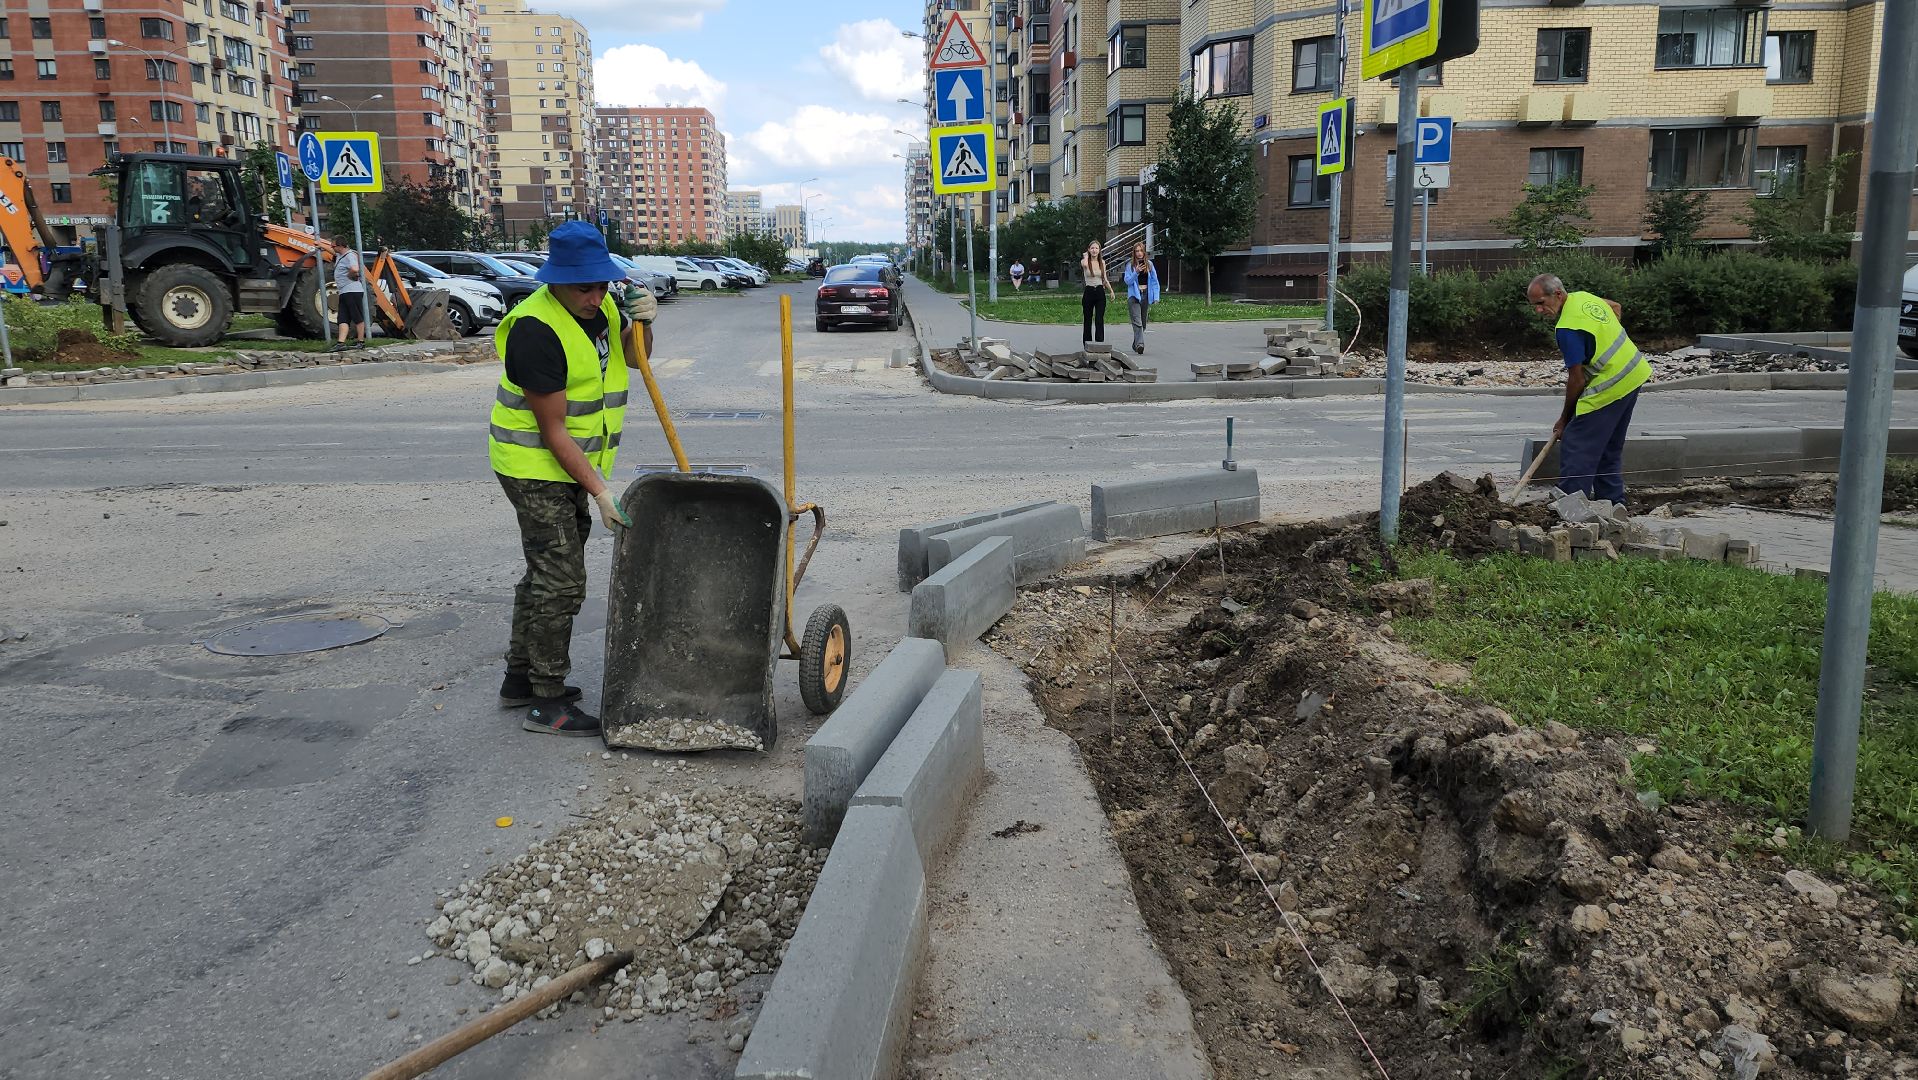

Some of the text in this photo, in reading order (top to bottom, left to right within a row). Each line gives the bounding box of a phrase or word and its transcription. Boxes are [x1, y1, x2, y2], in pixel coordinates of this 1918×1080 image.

[1416, 122, 1443, 159] P
[279, 156, 289, 184] P
[45, 217, 60, 225] ЕКИ
